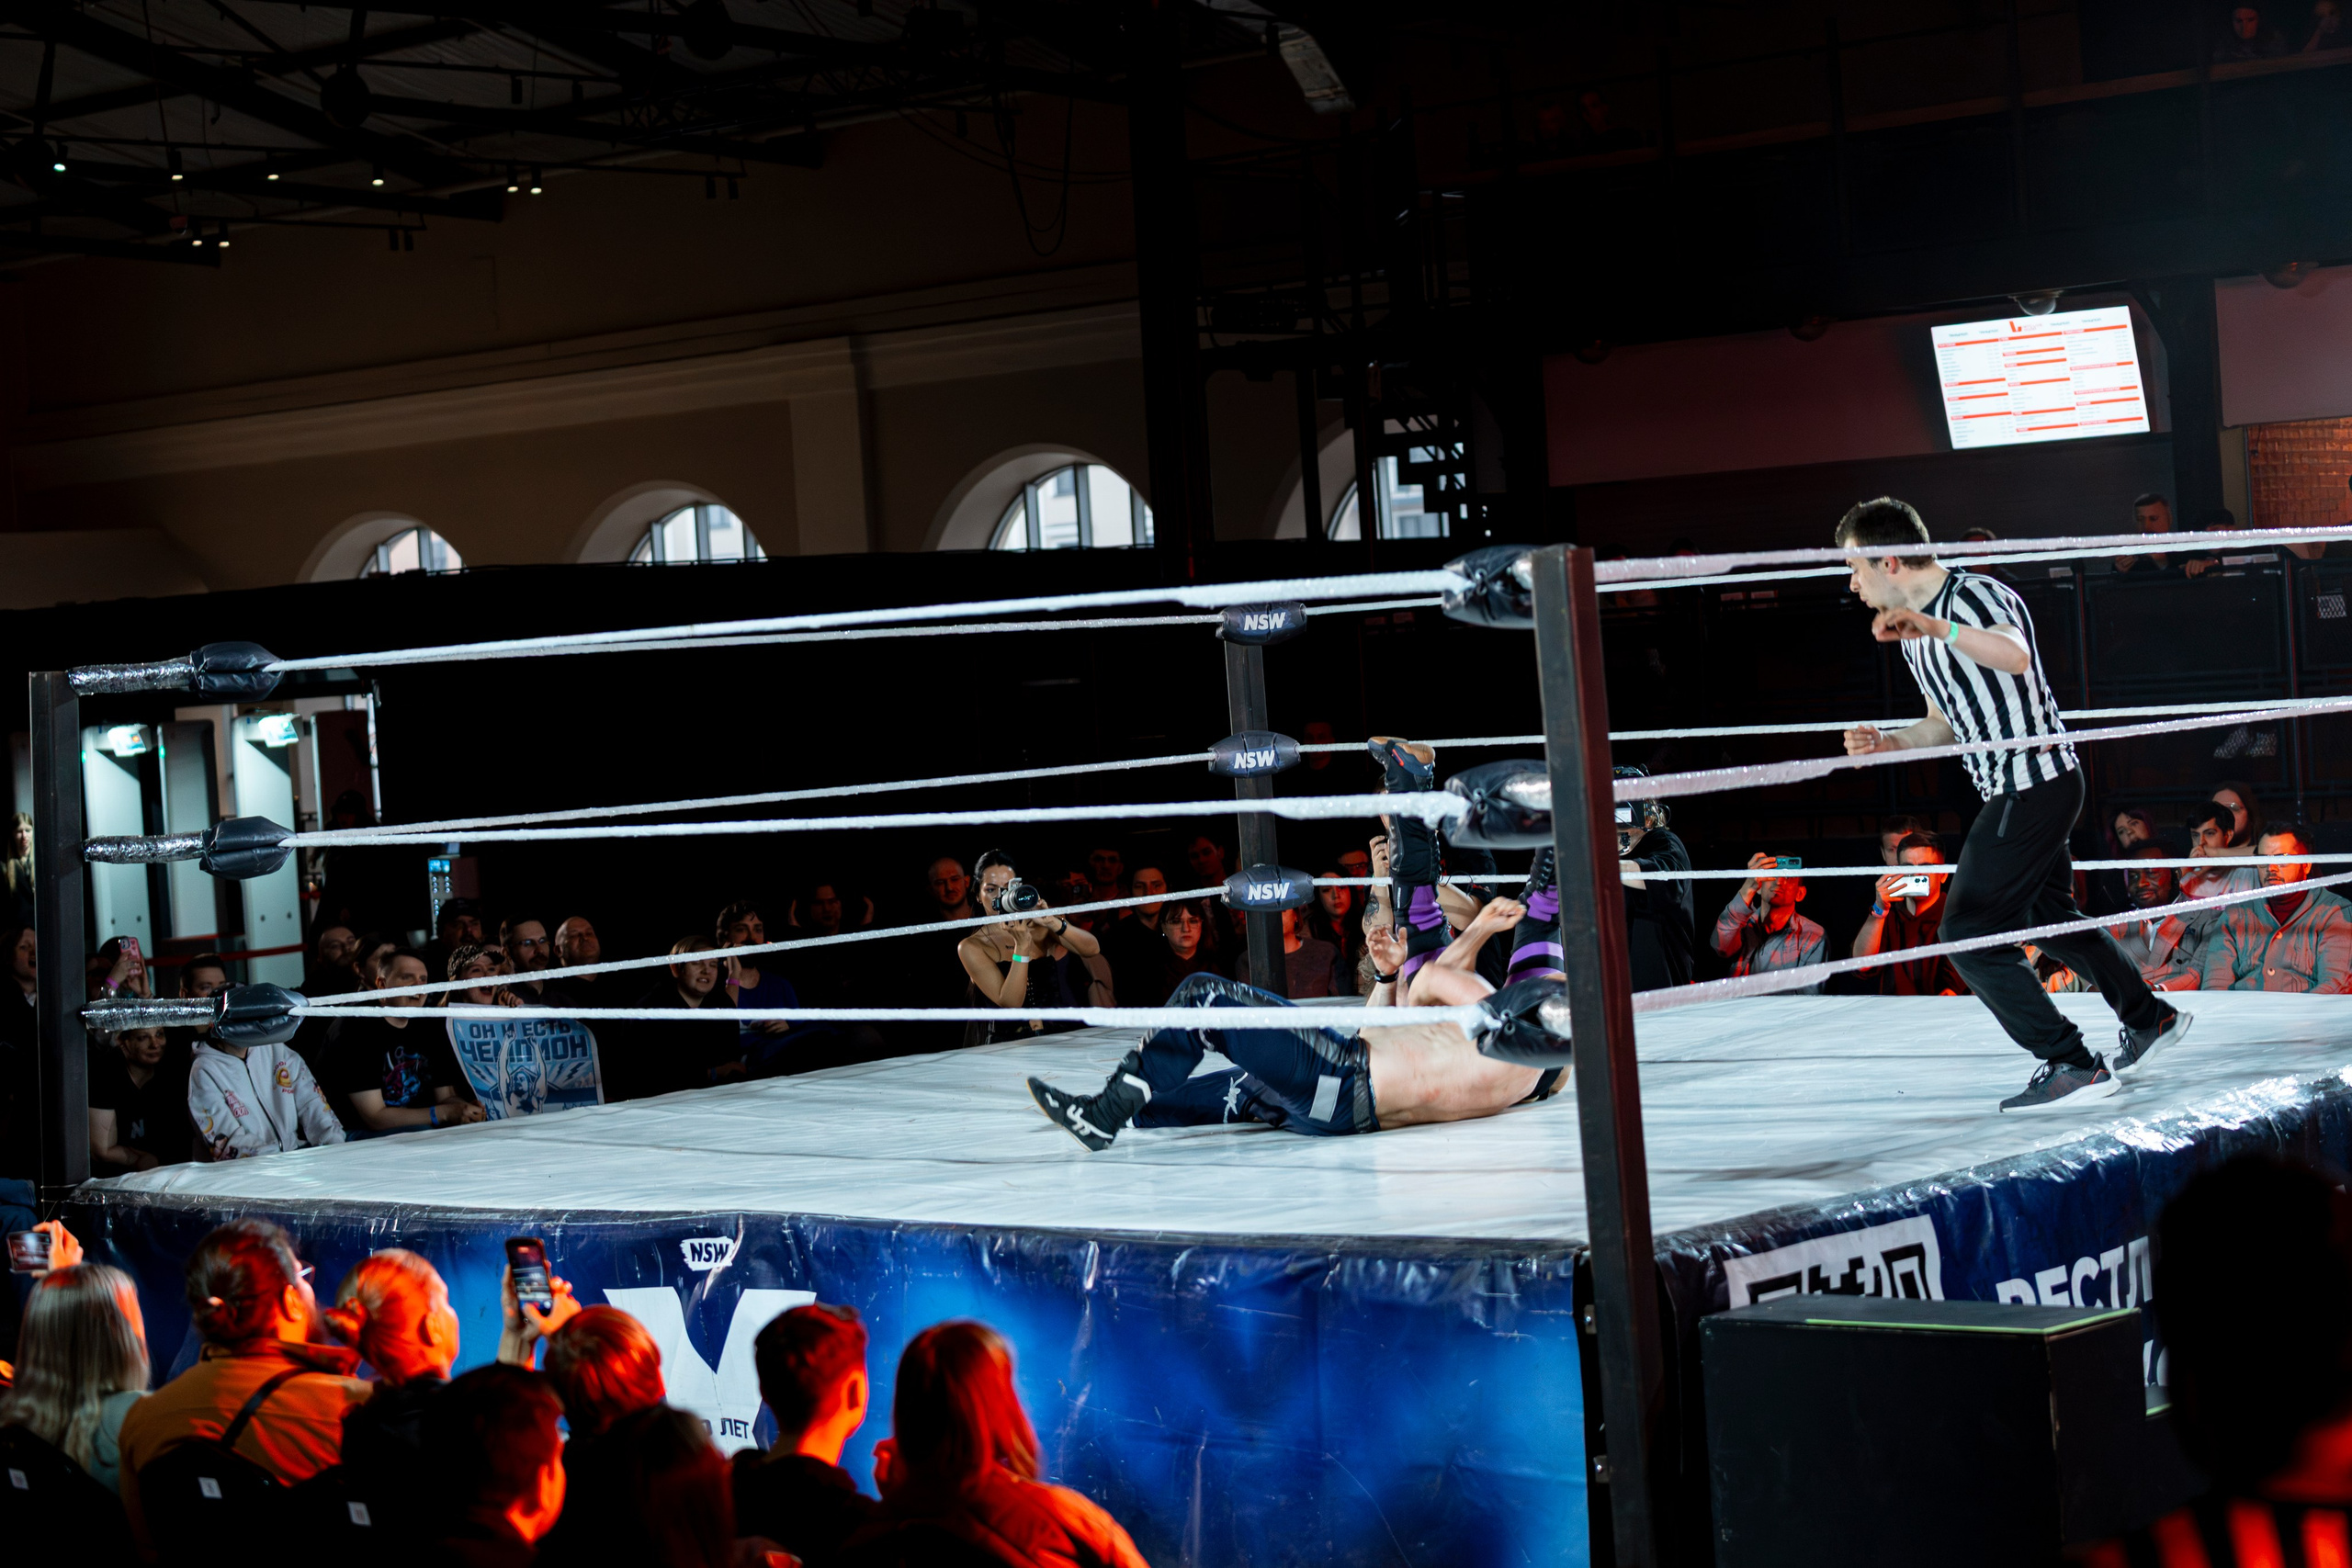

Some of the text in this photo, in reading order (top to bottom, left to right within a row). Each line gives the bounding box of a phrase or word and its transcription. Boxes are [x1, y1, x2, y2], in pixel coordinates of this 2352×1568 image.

[1244, 612, 1286, 631] NSW
[1234, 750, 1275, 769] NSW
[1247, 882, 1290, 901] NSW
[469, 1022, 495, 1039] ОН
[522, 1019, 571, 1037] ЕСТЬ
[690, 1242, 730, 1263] NSW
[720, 1417, 750, 1439] ЛЕТ
